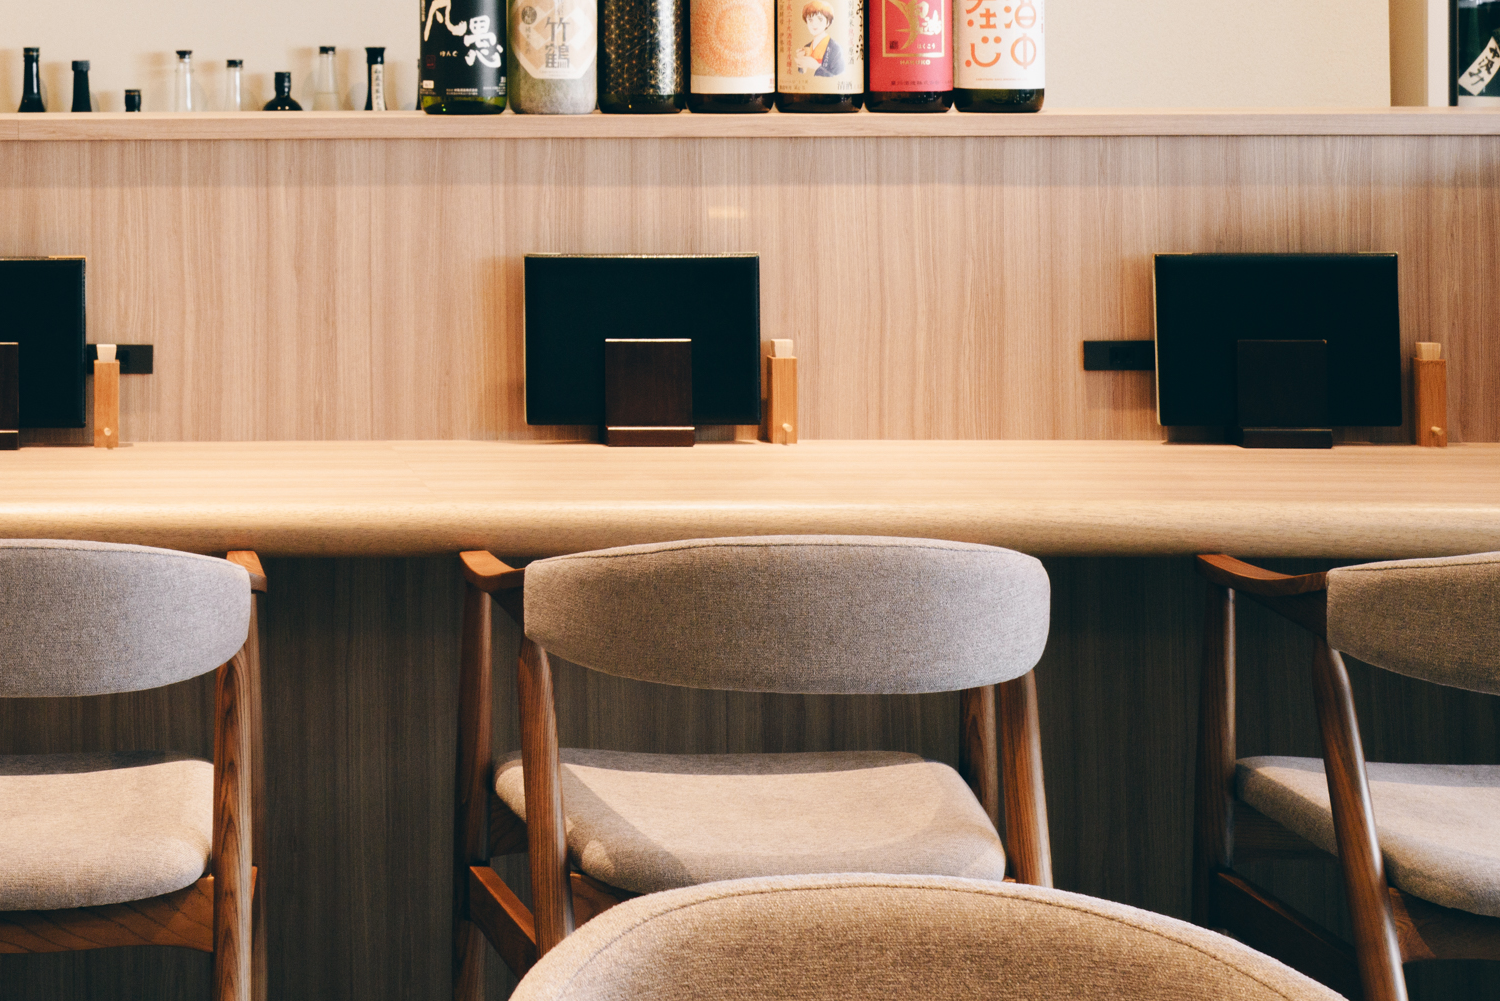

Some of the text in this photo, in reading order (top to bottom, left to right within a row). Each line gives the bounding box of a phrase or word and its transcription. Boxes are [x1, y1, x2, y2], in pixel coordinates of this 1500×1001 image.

[545, 16, 570, 69] 竹鶴
[916, 42, 936, 50] はくこう
